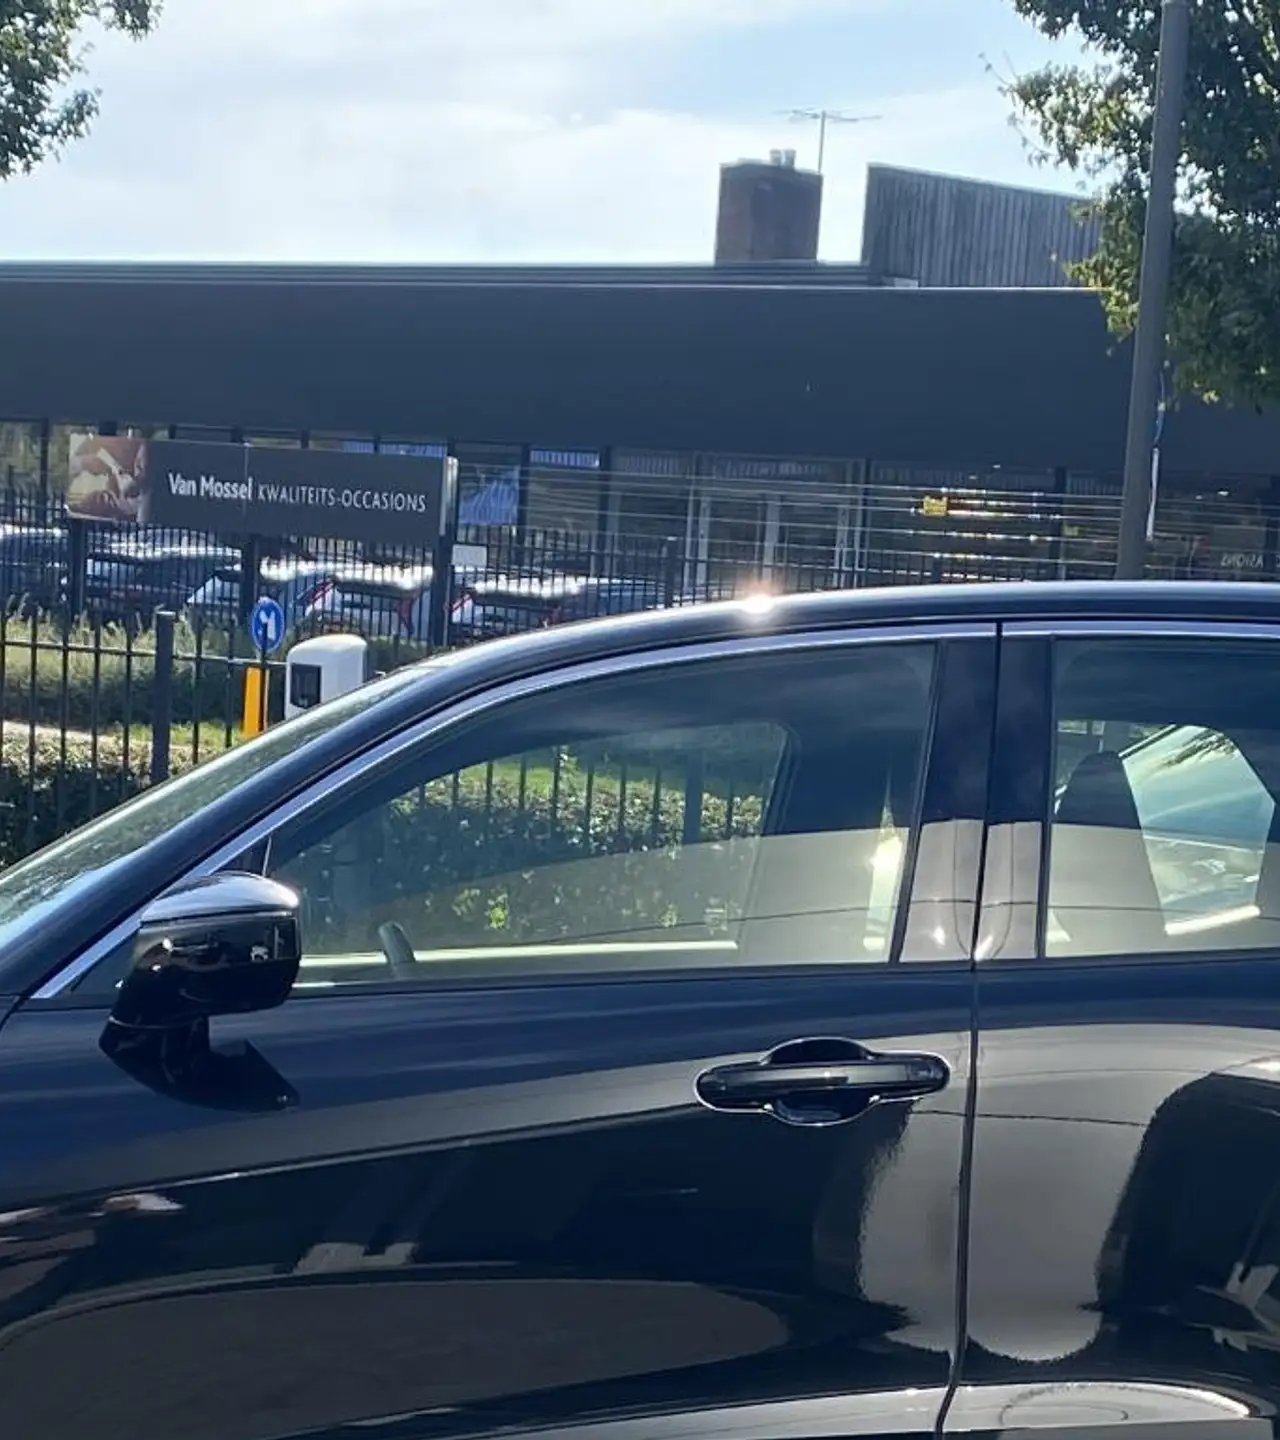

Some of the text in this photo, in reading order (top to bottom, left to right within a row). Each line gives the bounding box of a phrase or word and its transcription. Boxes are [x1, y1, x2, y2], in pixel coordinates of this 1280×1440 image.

[167, 472, 427, 513] Van Mossel KWALITEITS-OCCASIONS
